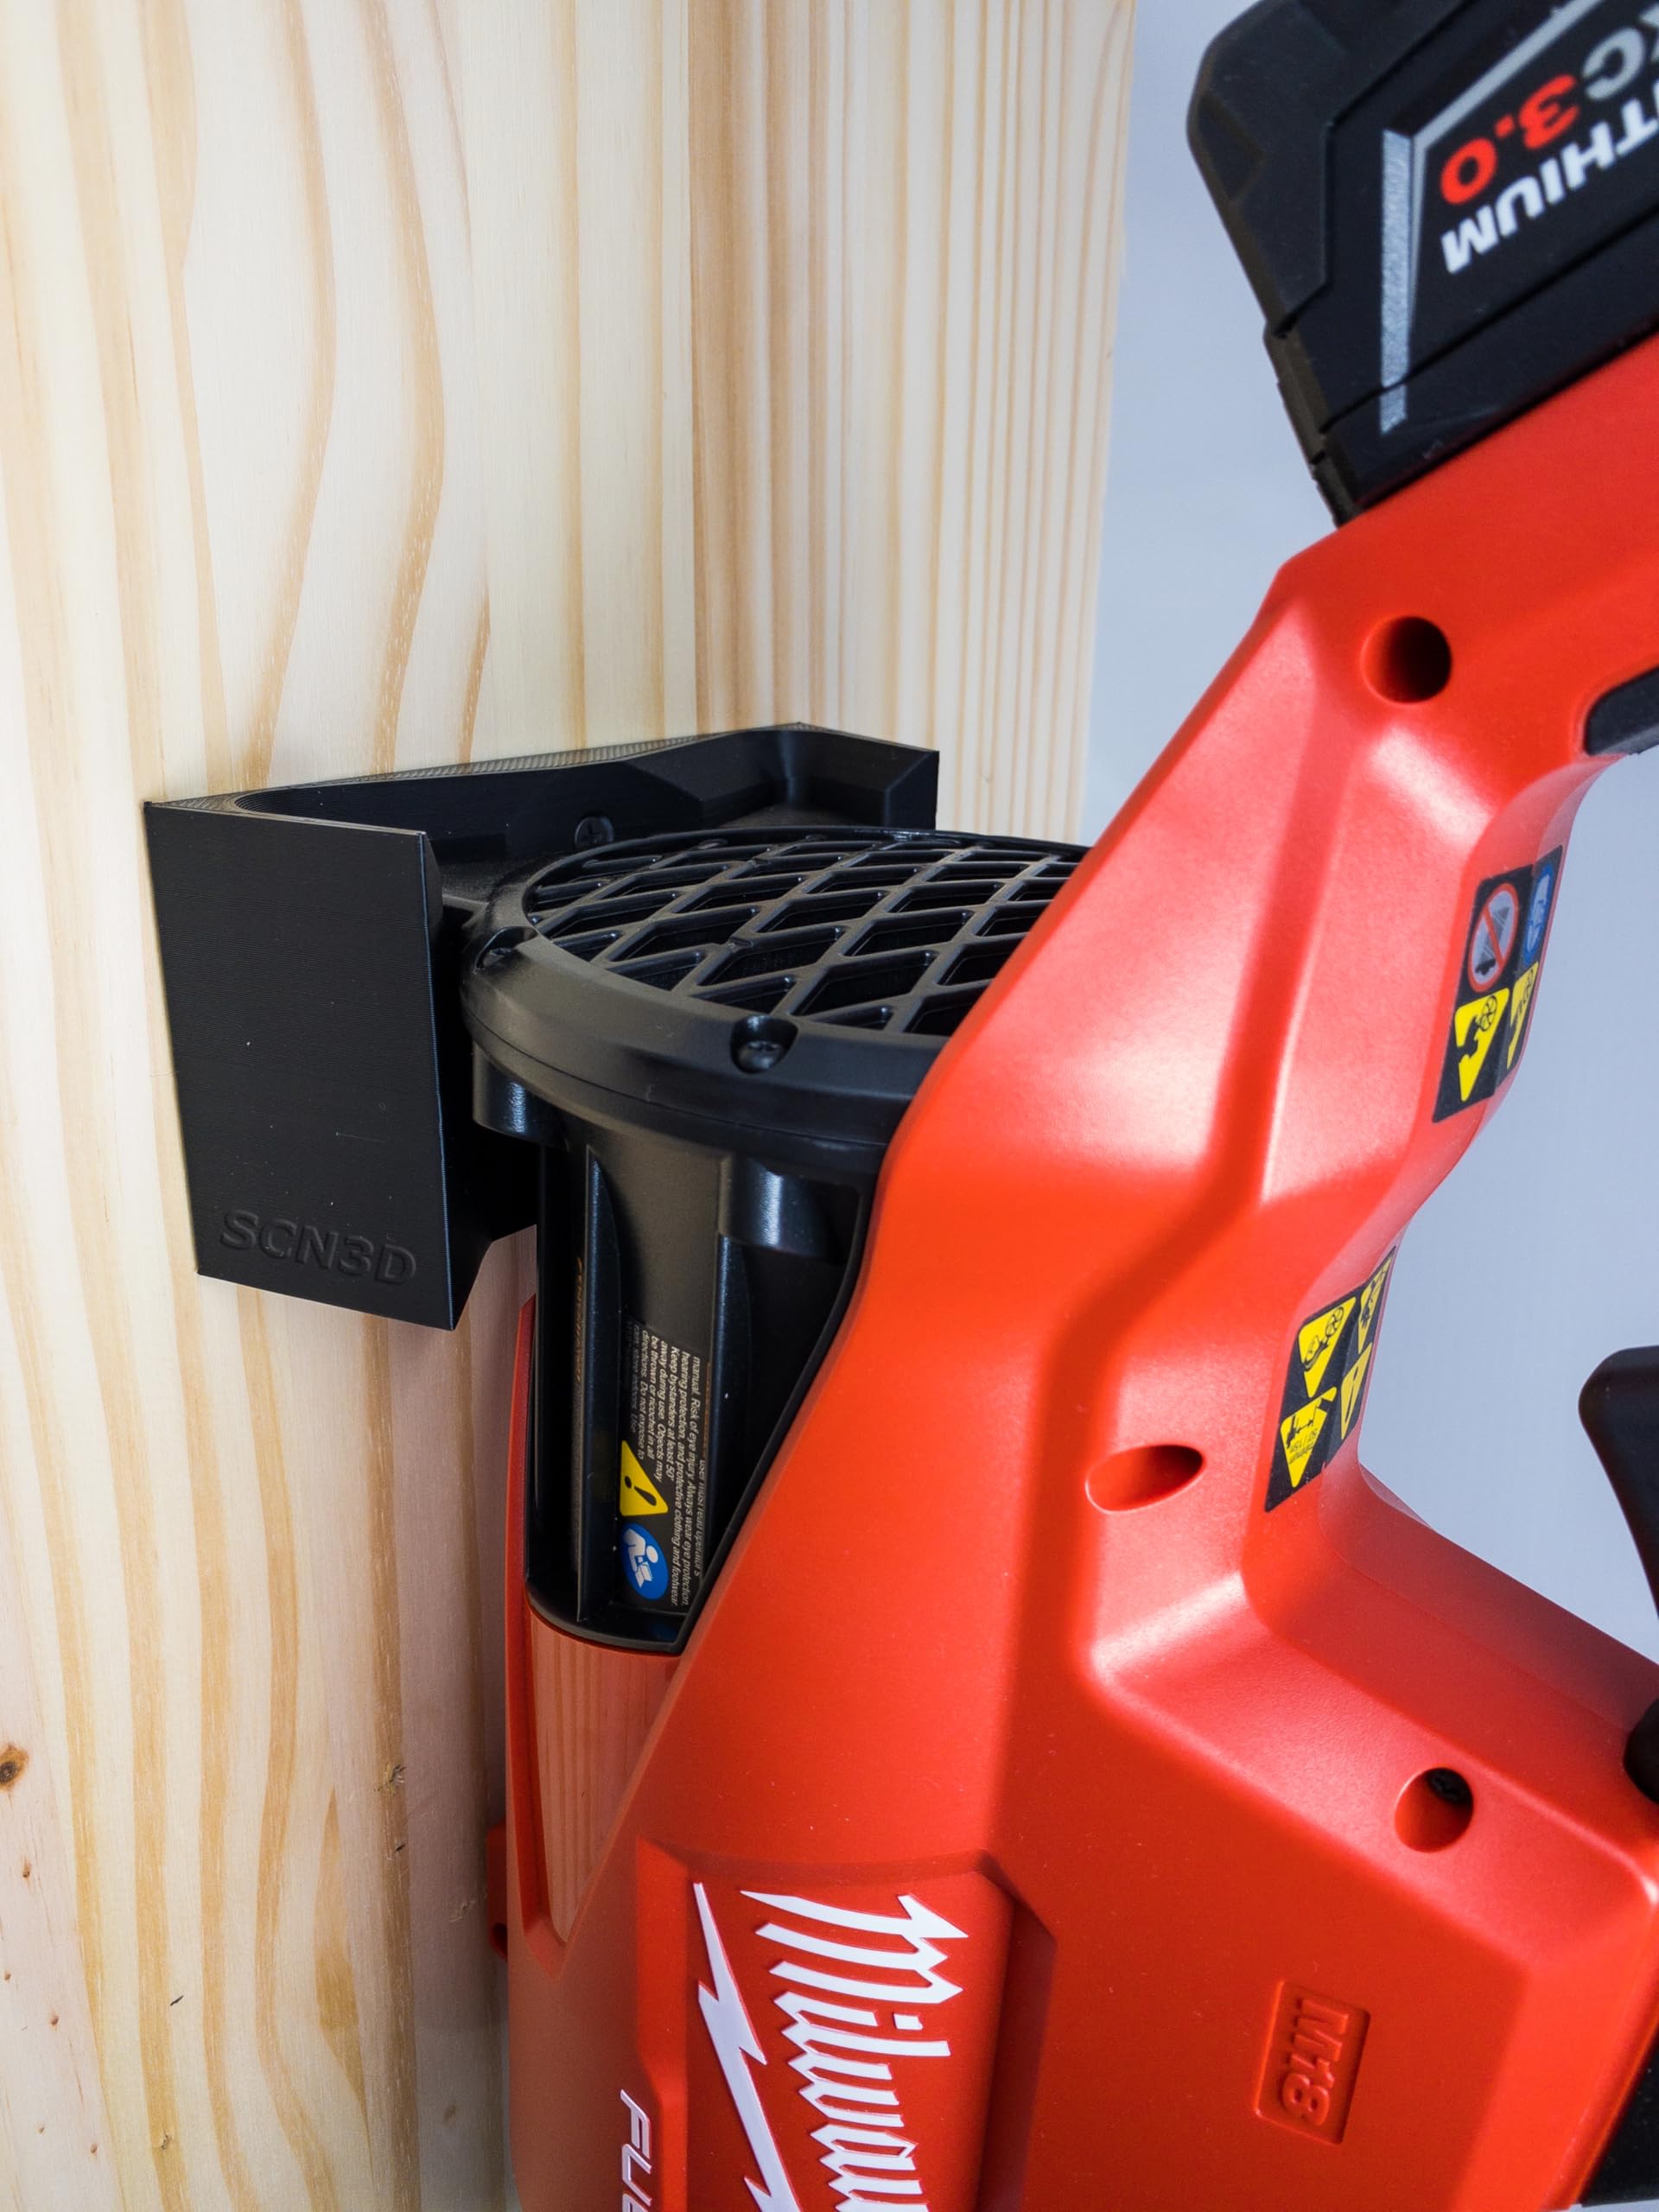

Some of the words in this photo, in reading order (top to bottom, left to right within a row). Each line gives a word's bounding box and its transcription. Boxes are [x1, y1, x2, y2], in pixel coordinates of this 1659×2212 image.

[1440, 73, 1580, 206] 3.0
[1440, 78, 1659, 275] THIUM
[220, 1210, 416, 1286] SCN3D
[651, 1336, 659, 1349] be
[659, 1341, 668, 1369] away
[650, 1351, 658, 1383] thrown
[670, 1346, 679, 1373] Keep
[678, 1351, 690, 1388] hearing
[691, 1357, 701, 1395] manual.
[640, 1382, 648, 1395] Do
[658, 1369, 667, 1402] during
[668, 1374, 678, 1427] bystanders
[647, 1396, 657, 1435] ricochet
[690, 1397, 700, 1419] Risk
[646, 1446, 655, 1459] all
[656, 1424, 666, 1459] Objects
[666, 1440, 676, 1464] least
[677, 1442, 686, 1462] and
[654, 1461, 663, 1483] may
[675, 1461, 684, 1508] protective
[685, 1481, 696, 1515] Always
[671, 1510, 682, 1545] clothing
[672, 1547, 681, 1567] and
[1280, 1998, 1349, 2126] M18
